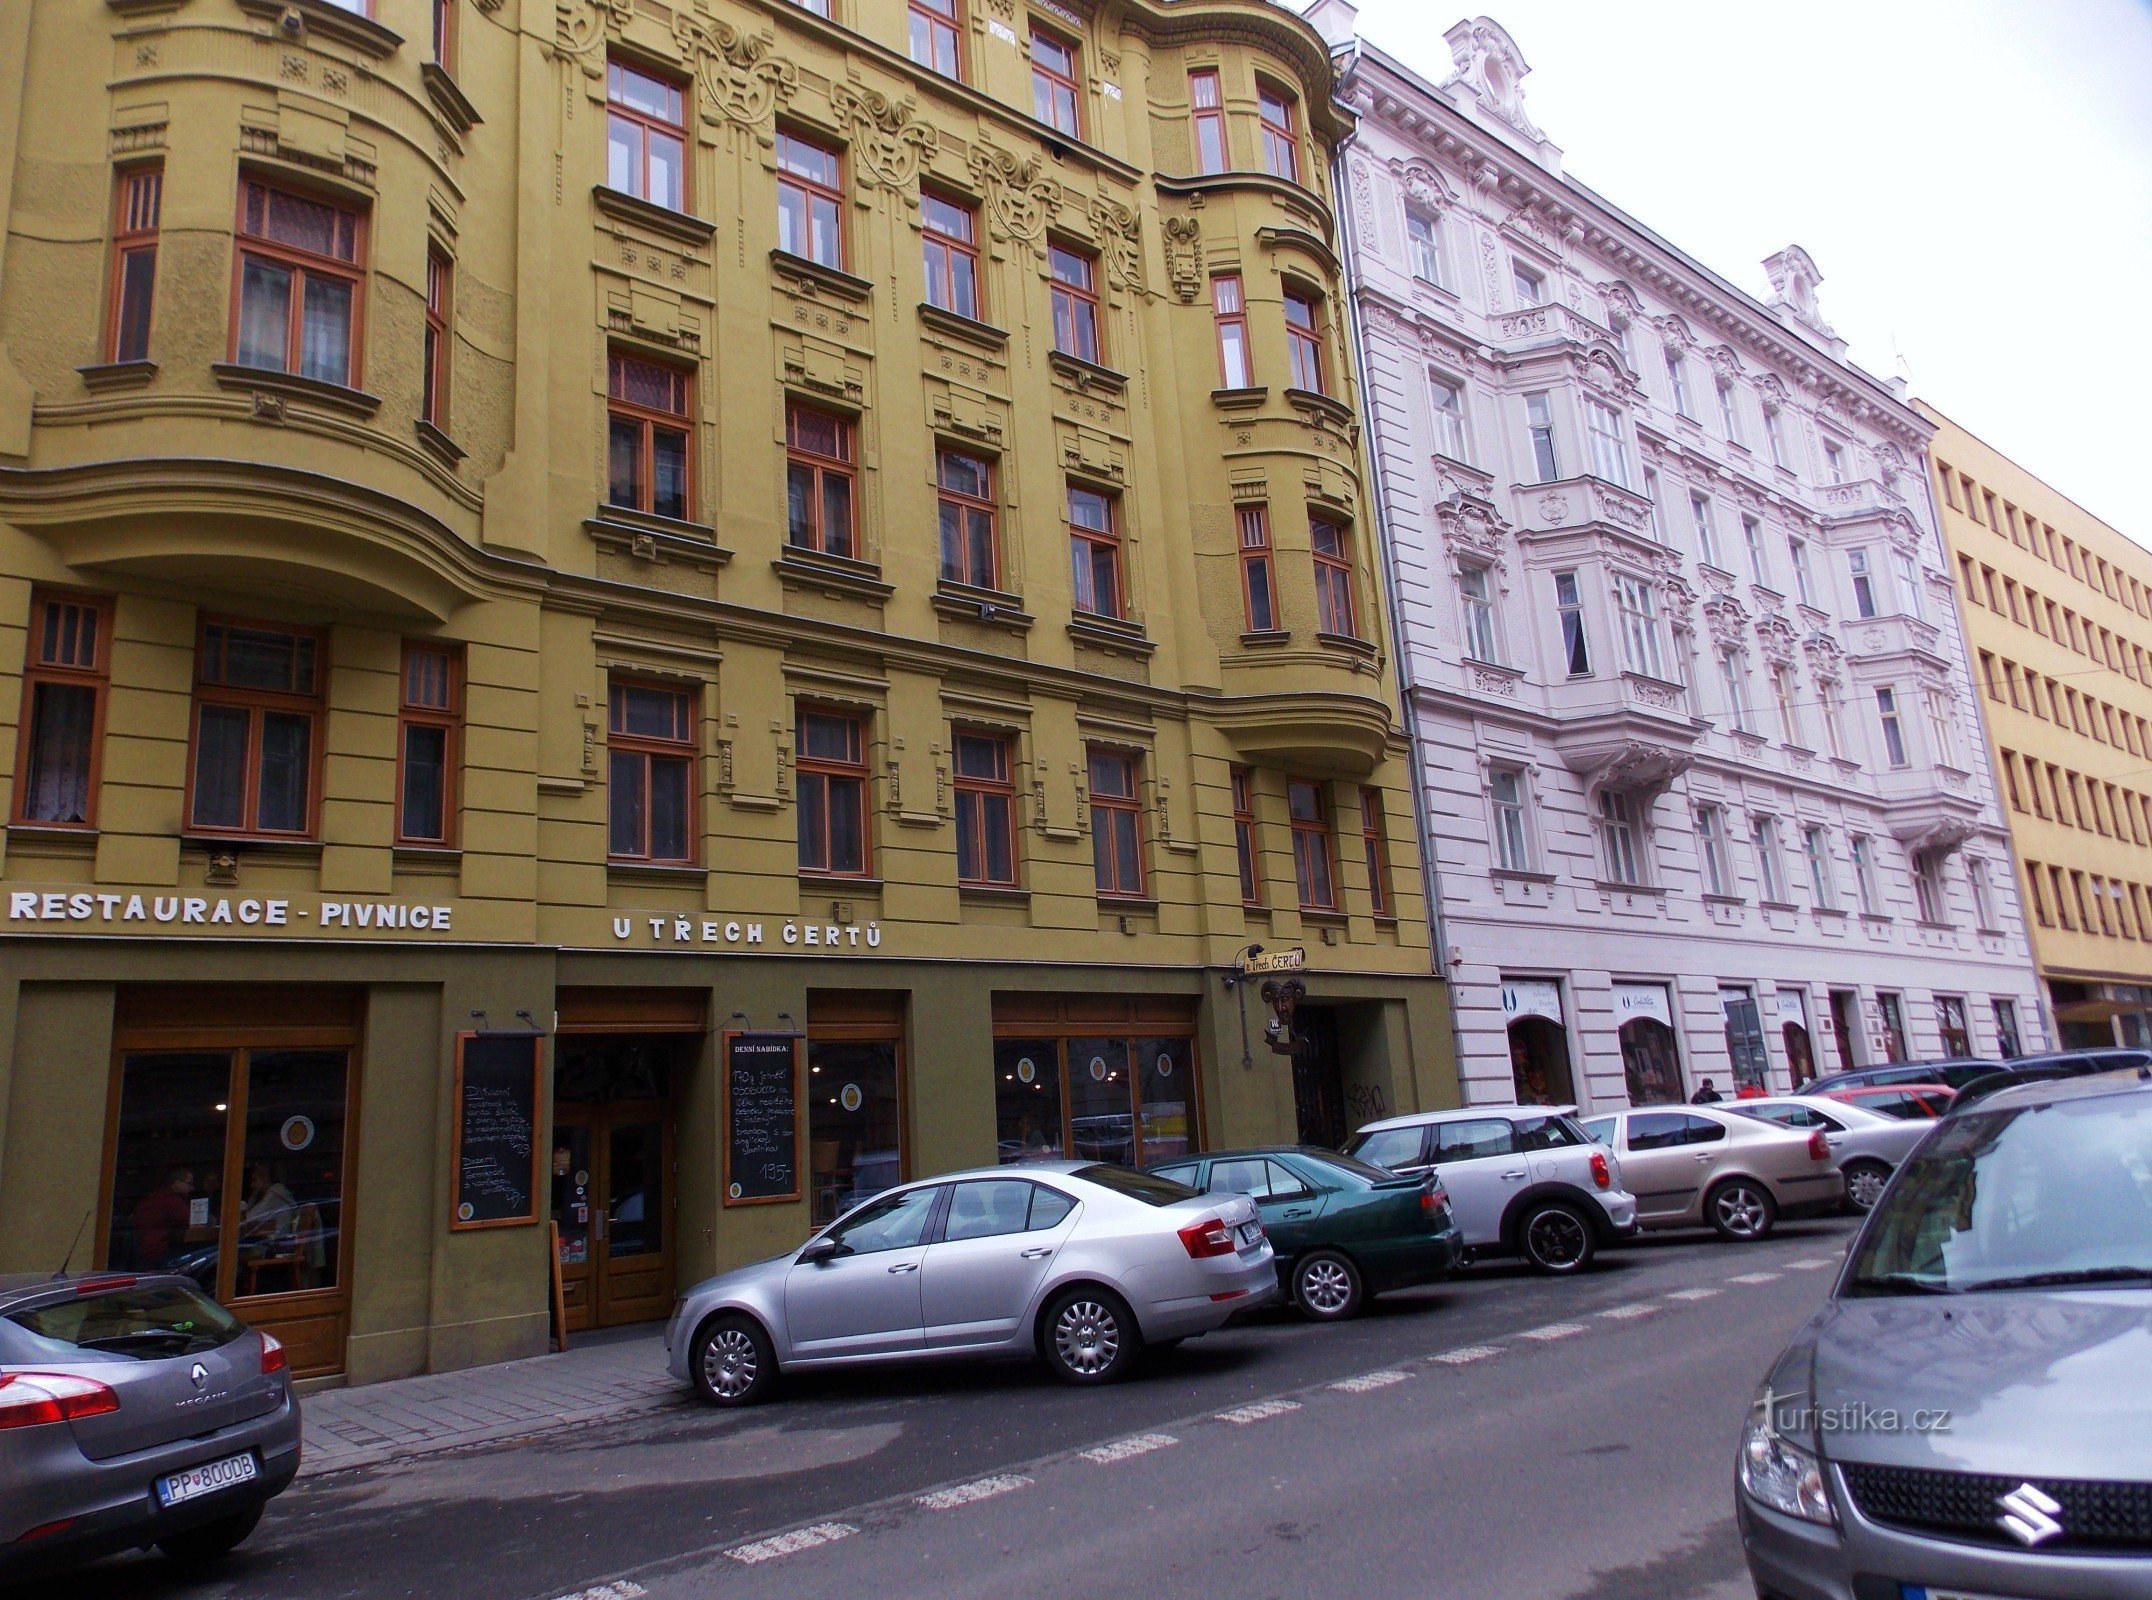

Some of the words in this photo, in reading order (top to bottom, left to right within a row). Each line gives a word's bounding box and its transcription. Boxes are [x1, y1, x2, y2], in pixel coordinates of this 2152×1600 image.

[9, 892, 288, 925] RESTAURACE
[320, 902, 451, 930] PIVNICE
[613, 918, 631, 938] U
[649, 914, 762, 943] TŘECH
[782, 919, 881, 947] ČERTŮ
[735, 1045, 755, 1053] DENNÍ
[756, 1044, 789, 1053] NABÍDKA:
